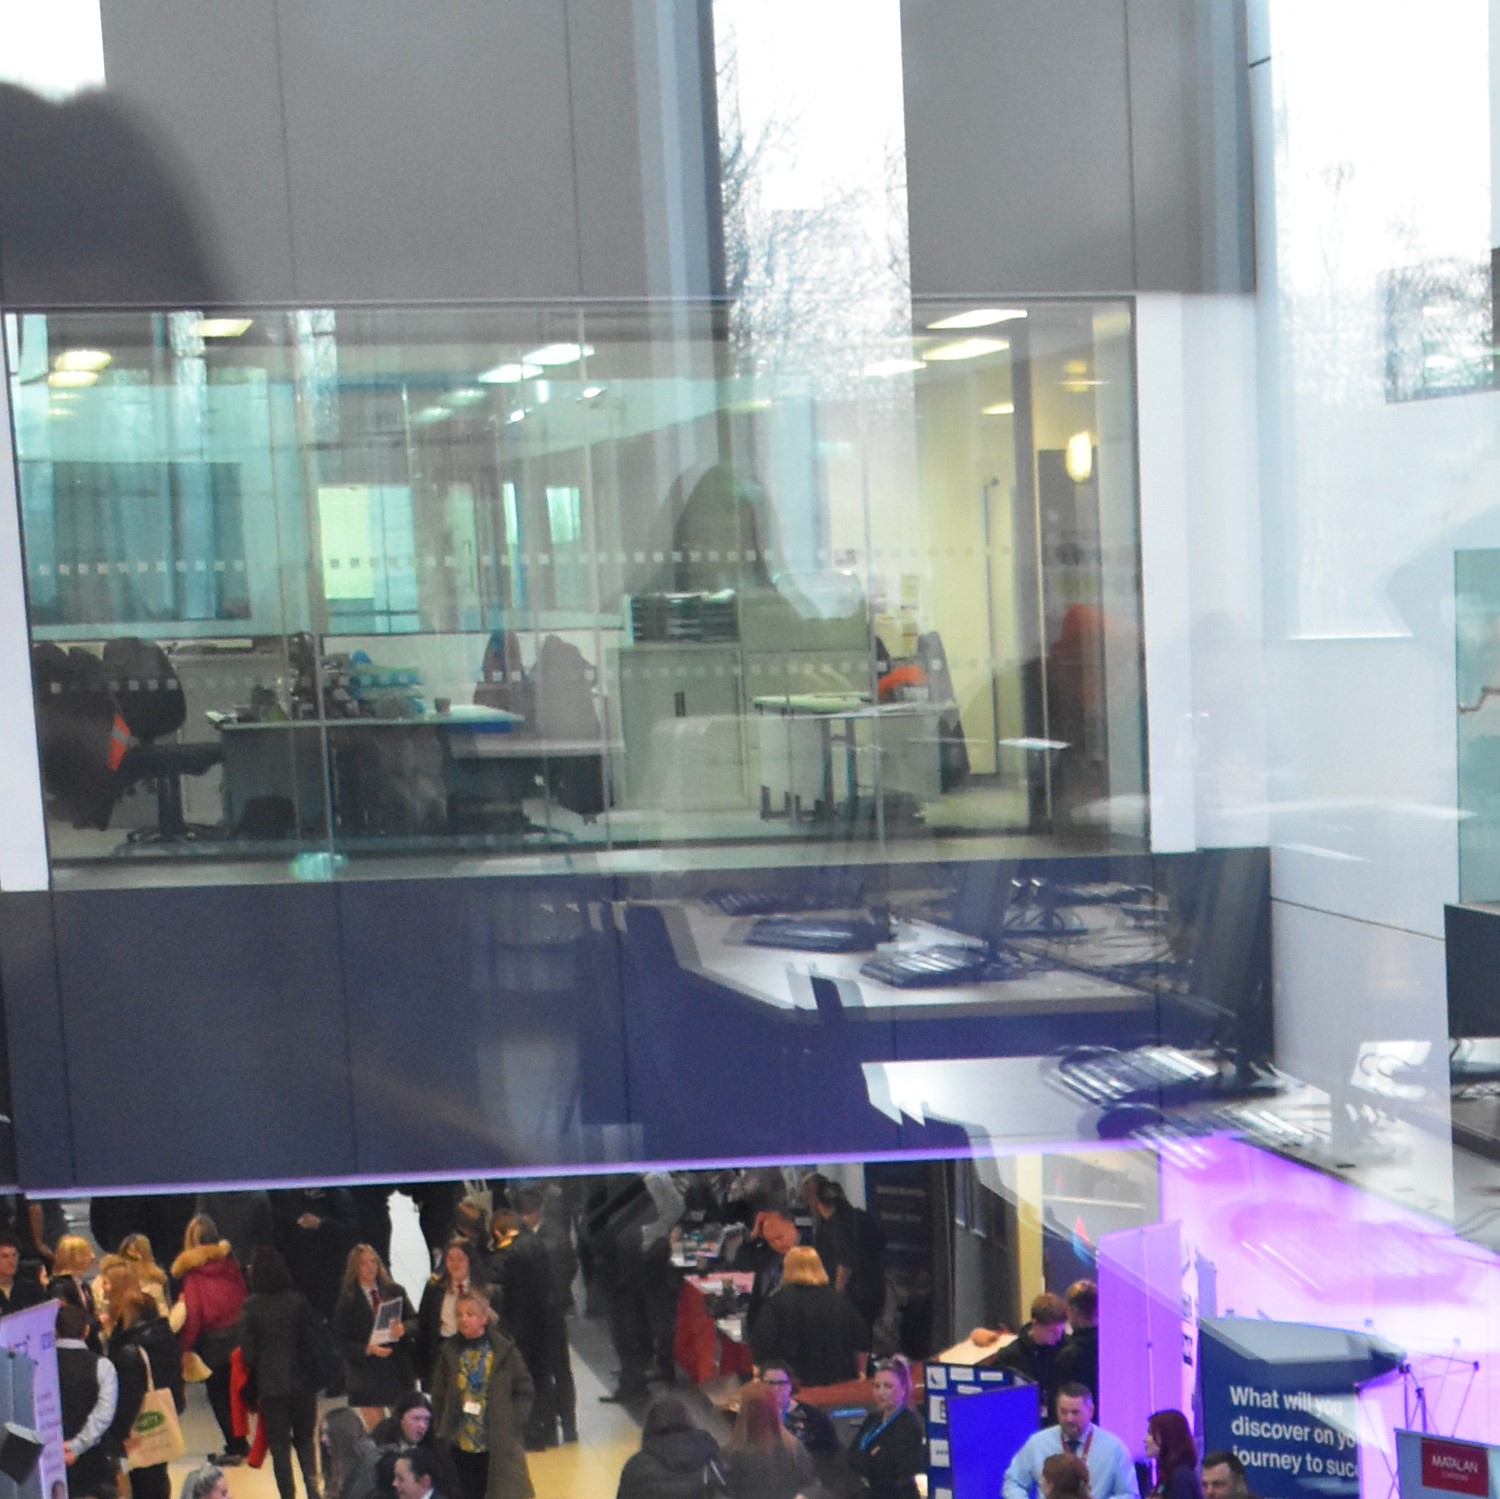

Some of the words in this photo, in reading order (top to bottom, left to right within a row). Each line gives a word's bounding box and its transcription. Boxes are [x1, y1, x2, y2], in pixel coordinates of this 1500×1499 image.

[1230, 1385, 1279, 1409] What
[1283, 1392, 1312, 1411] will
[1313, 1398, 1343, 1417] you
[1231, 1415, 1310, 1441] discover
[1314, 1428, 1334, 1445] on
[1306, 1453, 1323, 1472] to
[1432, 1455, 1479, 1473] MATALAN
